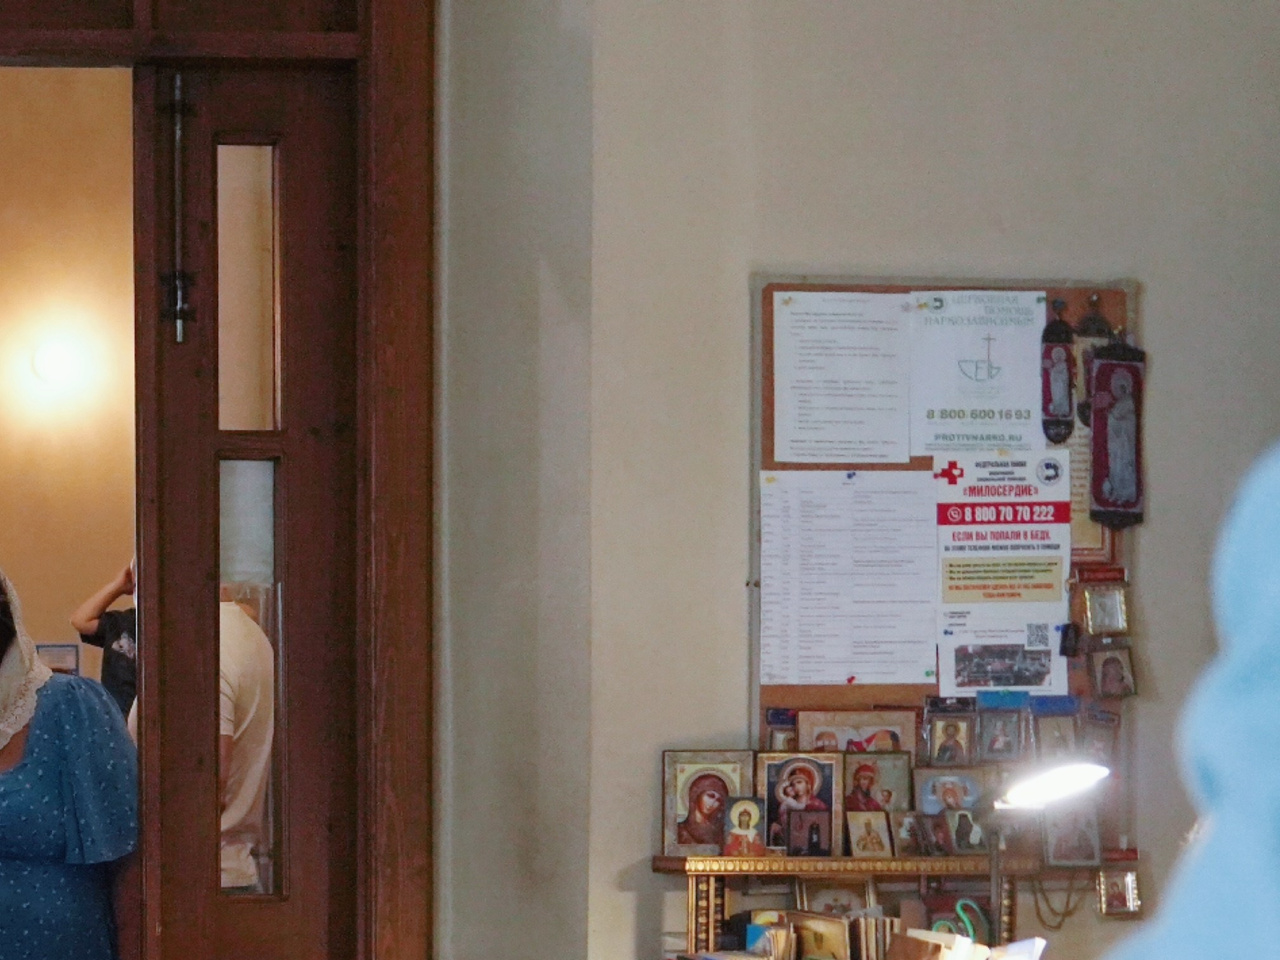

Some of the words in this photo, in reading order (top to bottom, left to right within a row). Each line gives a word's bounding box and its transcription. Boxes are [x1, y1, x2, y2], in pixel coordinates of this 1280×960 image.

[926, 409, 935, 420] 8
[940, 409, 966, 420] 800
[962, 484, 1039, 498] «МИЛОСЕРДИЕ»
[964, 506, 973, 522] 8
[975, 506, 997, 522] 800
[999, 505, 1014, 521] 70
[1016, 505, 1031, 521] 70
[1033, 505, 1055, 521] 222
[952, 531, 974, 542] ЕСЛИ
[975, 531, 988, 541] ВЫ
